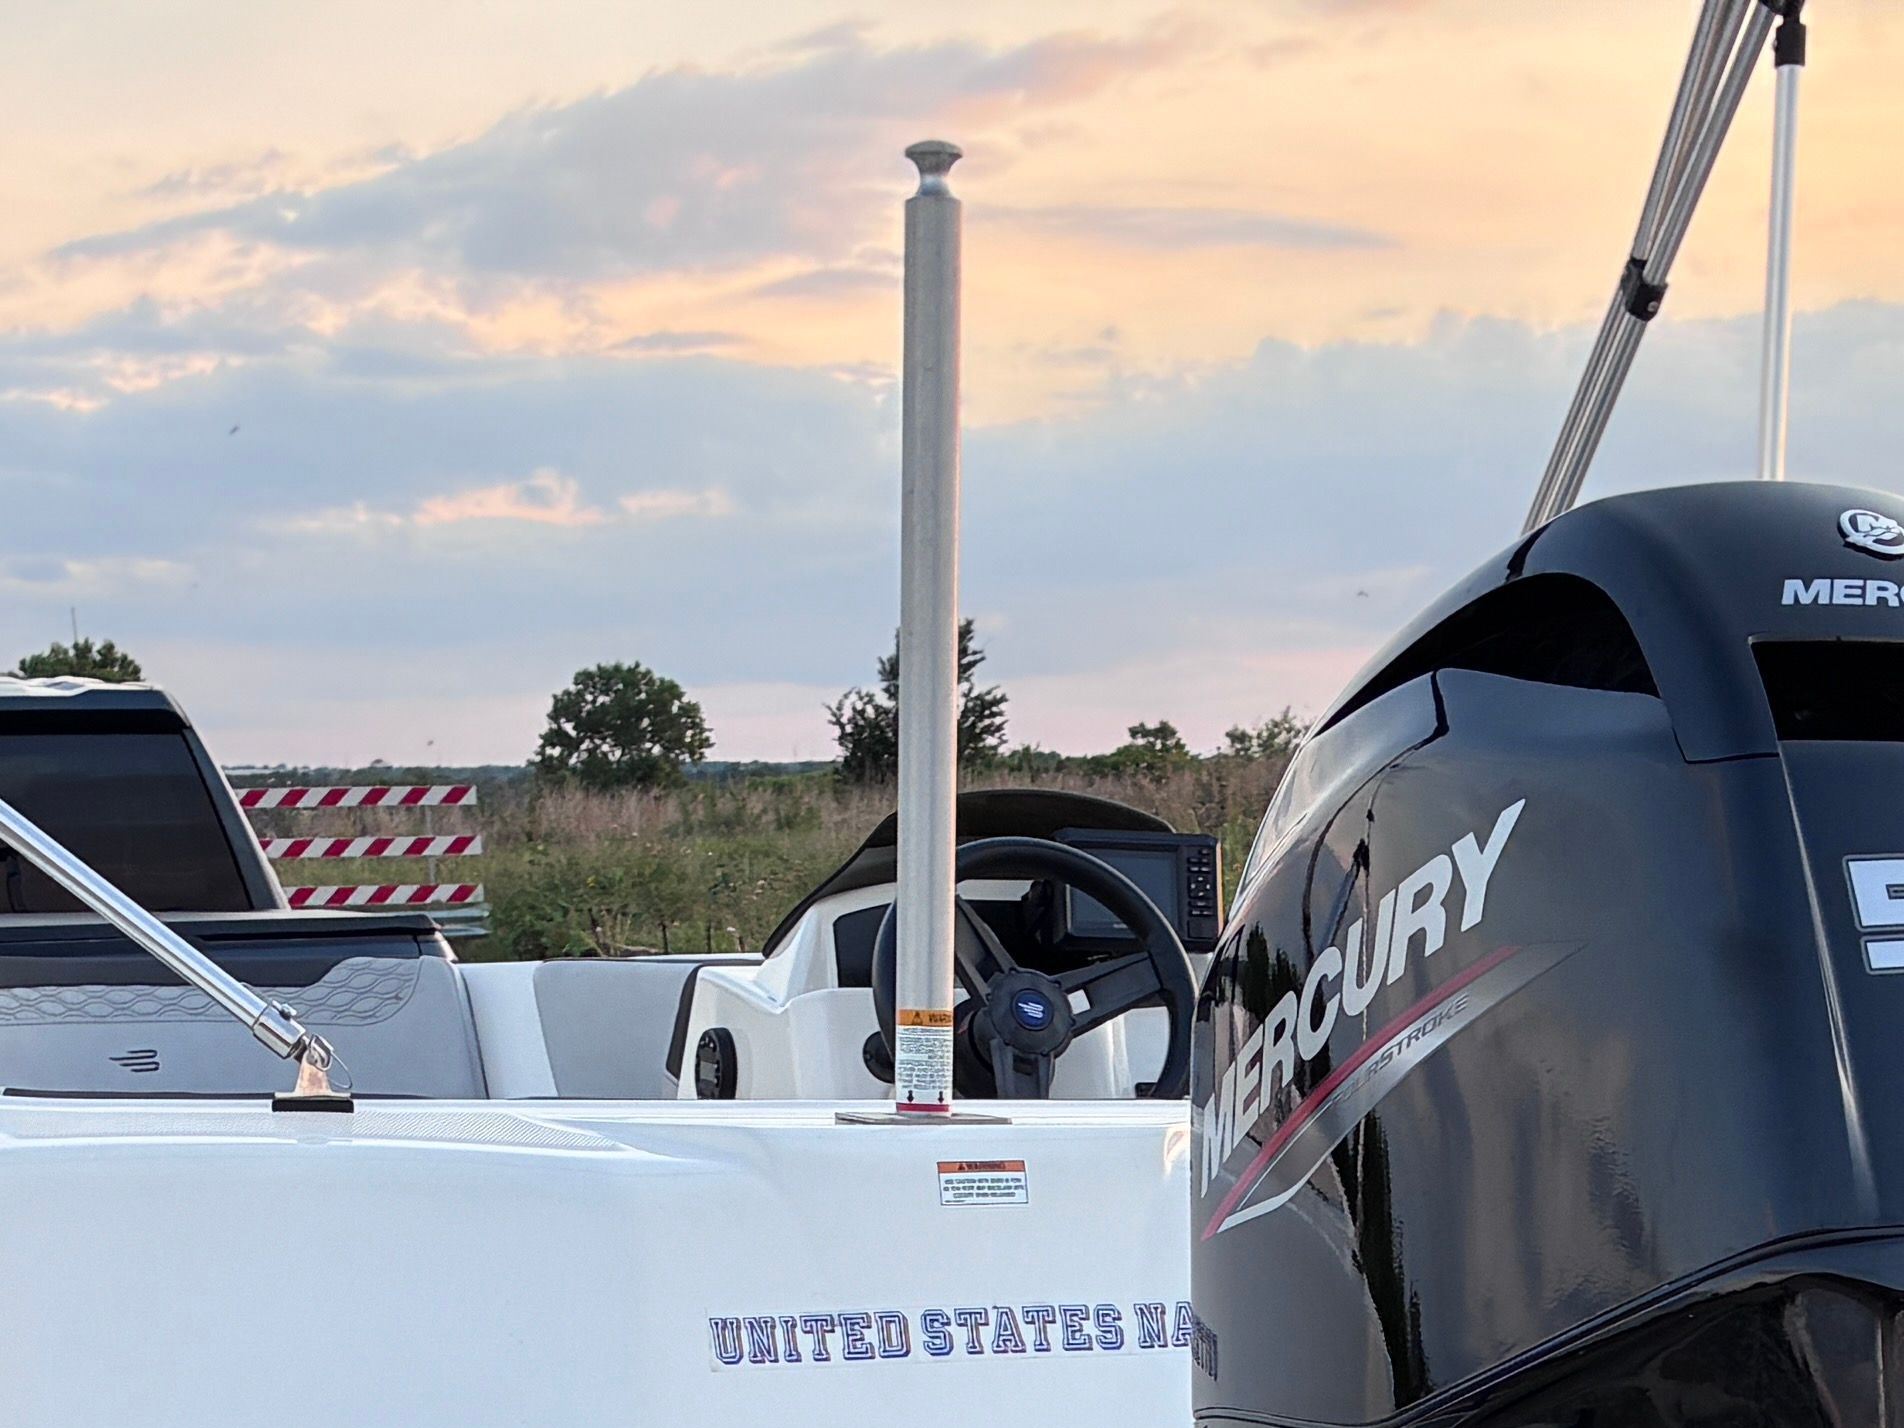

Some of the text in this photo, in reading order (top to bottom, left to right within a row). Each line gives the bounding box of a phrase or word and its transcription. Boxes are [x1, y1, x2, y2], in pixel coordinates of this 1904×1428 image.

[1201, 798, 1526, 1198] MERCURY
[709, 1301, 1194, 1365] UNITED STATES NA
